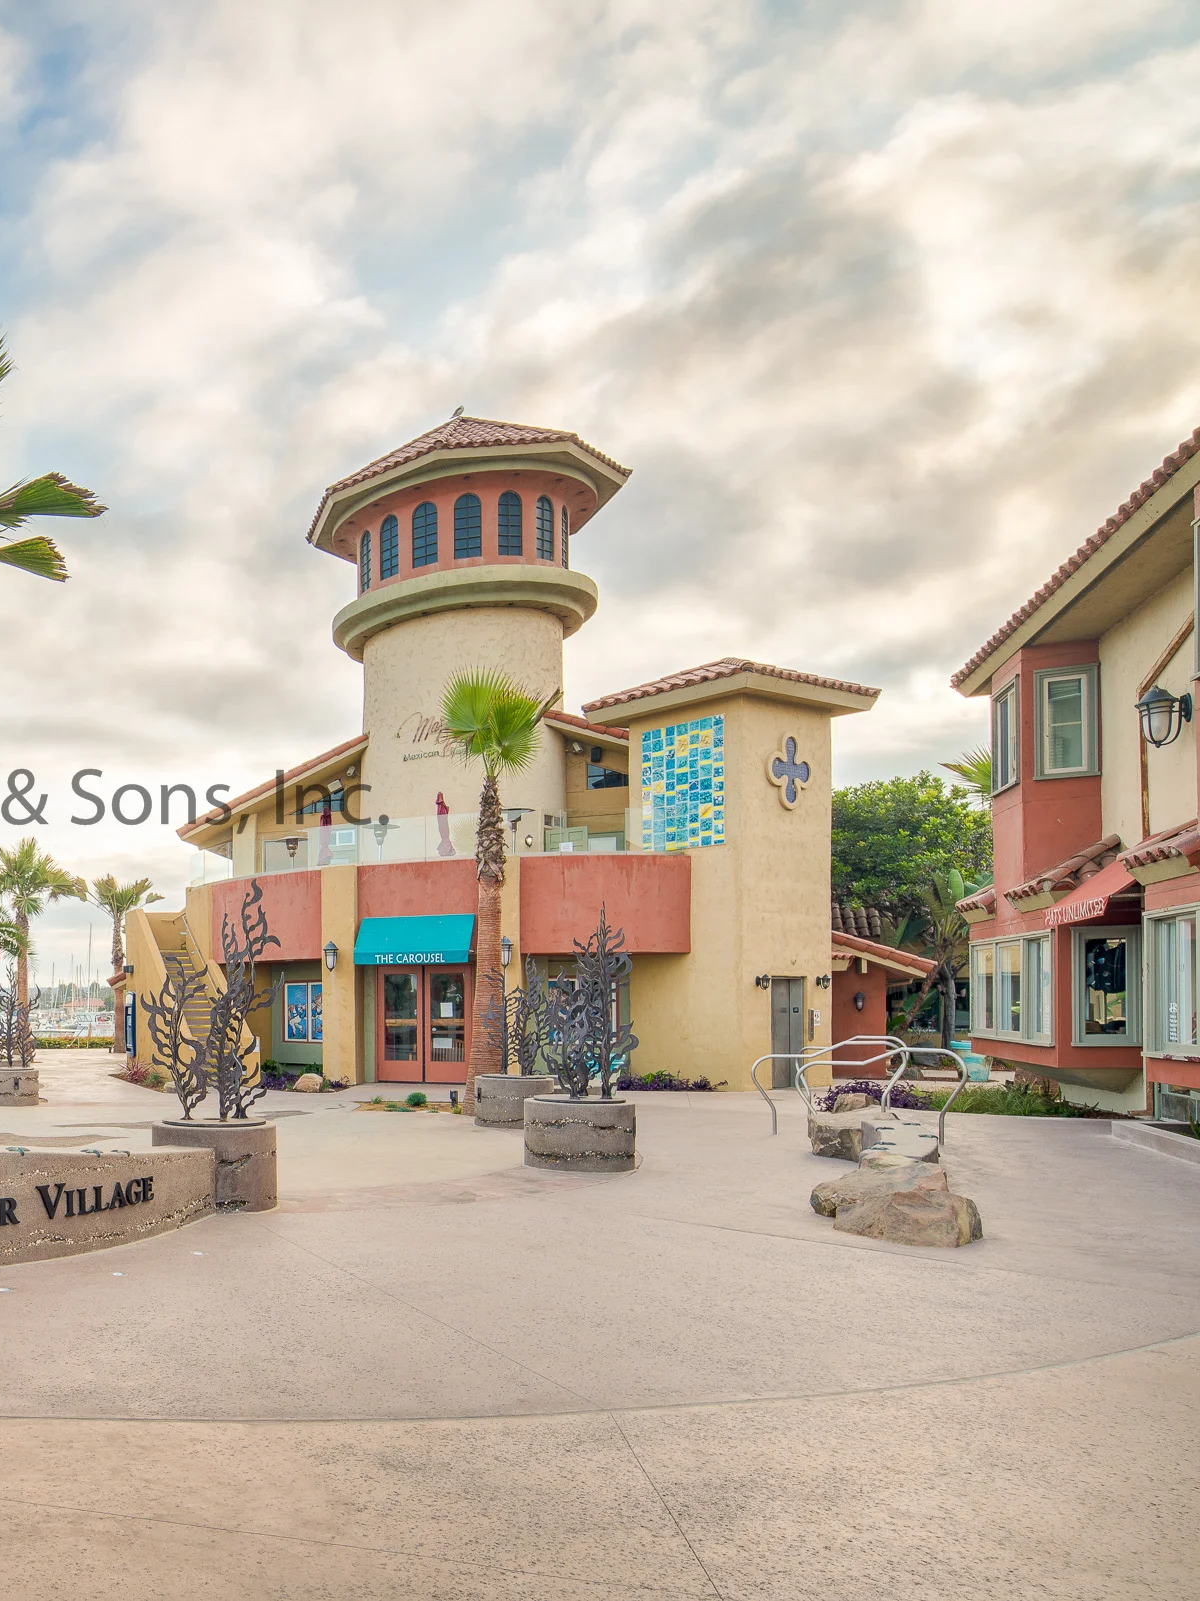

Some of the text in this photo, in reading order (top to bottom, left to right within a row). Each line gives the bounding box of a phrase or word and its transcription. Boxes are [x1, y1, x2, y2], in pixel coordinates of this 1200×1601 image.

[403, 750, 440, 762] Mexican
[1044, 897, 1104, 925] HATS UNLIMITED
[375, 952, 445, 964] THE CAROUSEL
